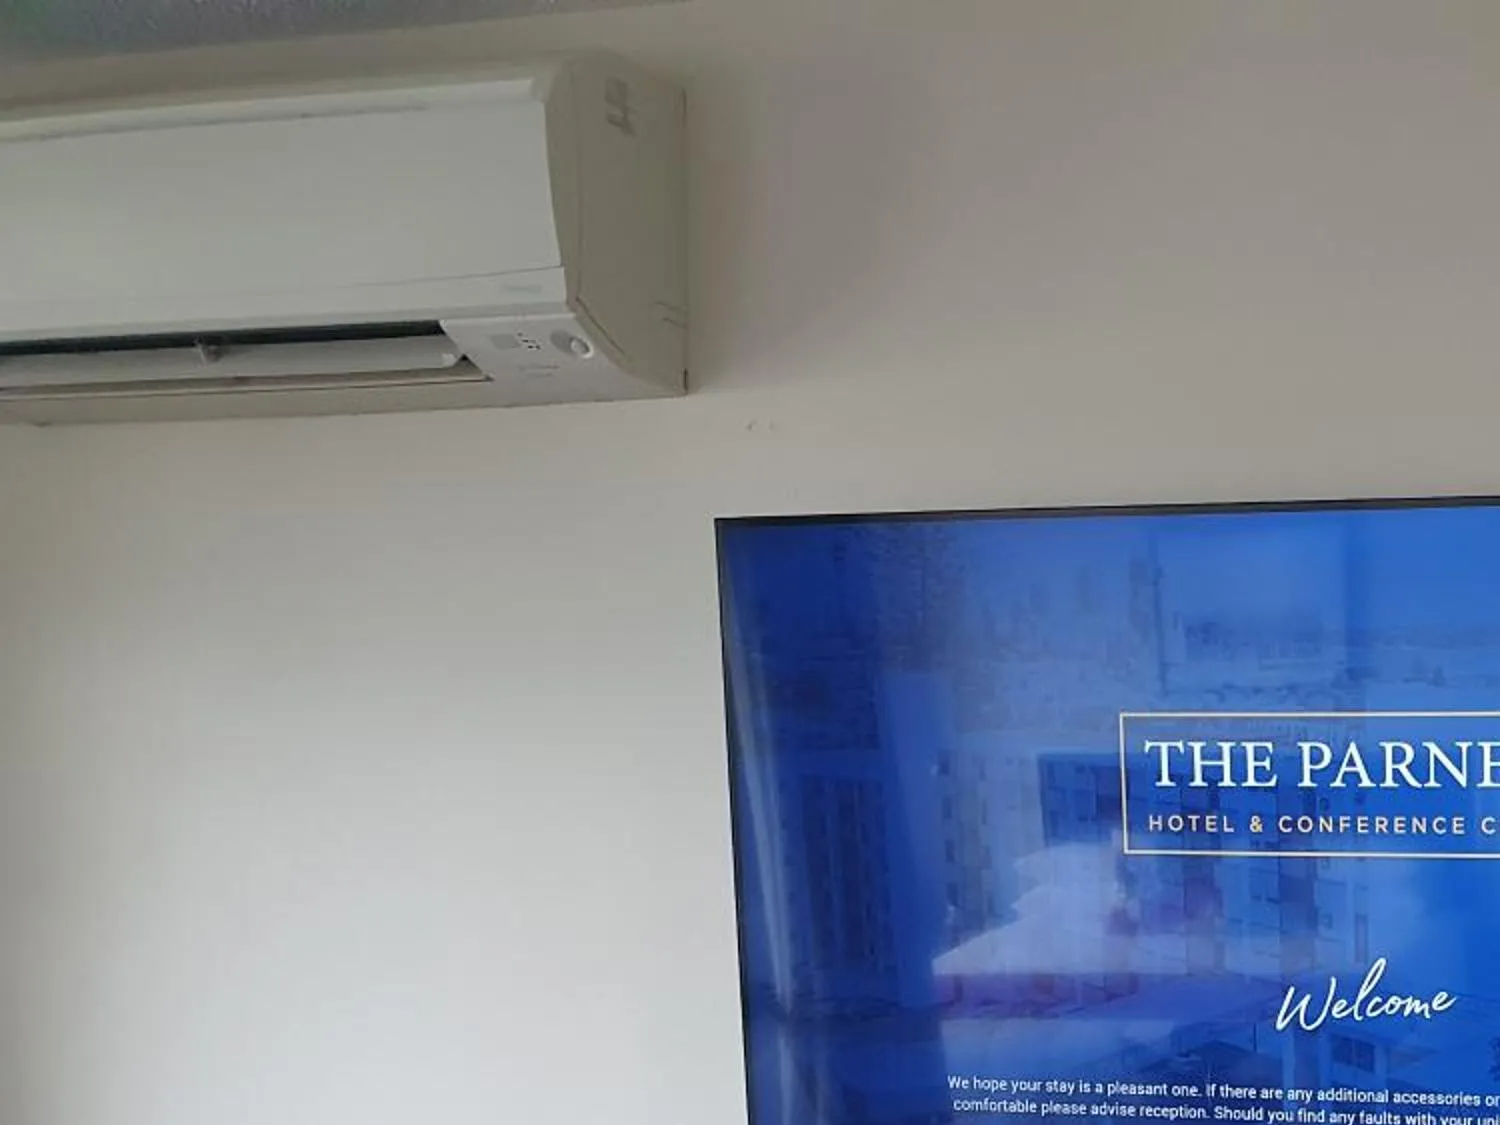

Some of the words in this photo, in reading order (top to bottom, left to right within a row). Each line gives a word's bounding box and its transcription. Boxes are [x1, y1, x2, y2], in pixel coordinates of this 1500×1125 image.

[1144, 740, 1278, 788] THE
[1148, 814, 1235, 833] HOTEL
[1249, 814, 1263, 833] &
[1278, 815, 1466, 835] CONFERENCE
[1275, 957, 1457, 1031] Welcome
[947, 1075, 969, 1090] We
[973, 1078, 1008, 1094] hope
[1011, 1081, 1042, 1095] your
[1045, 1081, 1075, 1095] stay
[1079, 1079, 1091, 1093] is
[1095, 1083, 1103, 1094] a
[1107, 1081, 1168, 1097] pleasant
[1172, 1085, 1201, 1097] one.
[1206, 1083, 1217, 1097] If
[1219, 1084, 1256, 1099] there
[1260, 1088, 1283, 1100] are
[1287, 1089, 1313, 1104] any
[1317, 1086, 1389, 1104] additional
[1393, 1092, 1481, 1106] accessories
[1485, 1095, 1500, 1107] or
[953, 1097, 1037, 1113] comfortable
[1041, 1100, 1087, 1116] please
[1091, 1100, 1136, 1116] advise
[1139, 1104, 1211, 1121] reception.
[1214, 1106, 1263, 1121] Should
[1267, 1110, 1294, 1124] you
[1297, 1107, 1325, 1123] find
[1359, 1111, 1401, 1125] faults
